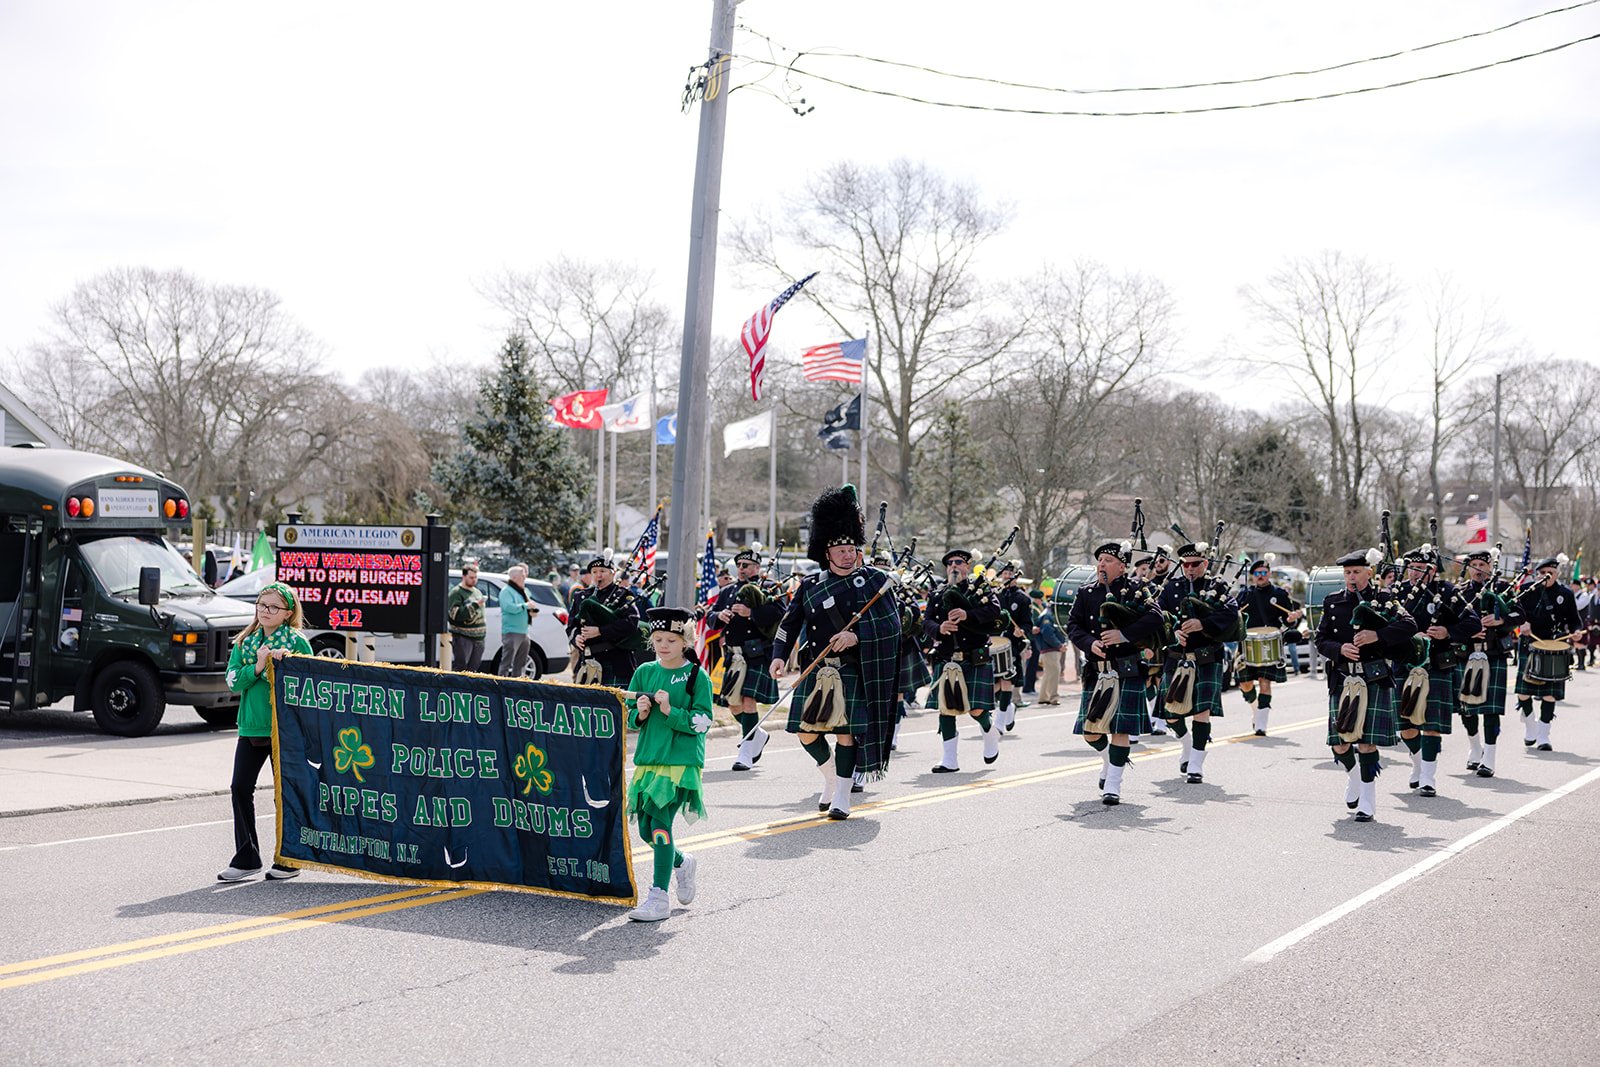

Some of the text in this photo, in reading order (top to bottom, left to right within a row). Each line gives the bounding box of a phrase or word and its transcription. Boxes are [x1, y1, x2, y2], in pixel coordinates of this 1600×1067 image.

[301, 528, 398, 539] AMERICAN LEGION
[279, 551, 319, 568] WOW
[321, 552, 421, 571] WEDNESDAYS
[278, 568, 422, 586] 5PM TO 8PM BURGERS
[324, 587, 332, 605] /
[335, 588, 410, 605] COLESLAW
[329, 607, 363, 630] $12
[671, 672, 691, 684] Luck
[283, 675, 616, 739] EASTERN LONG ISLAND
[391, 742, 499, 779] POLICE
[319, 781, 594, 839] PIPES AND DRUMS
[300, 826, 421, 865] SOUTHAMPTON, N.Y.
[547, 855, 583, 877] EST.
